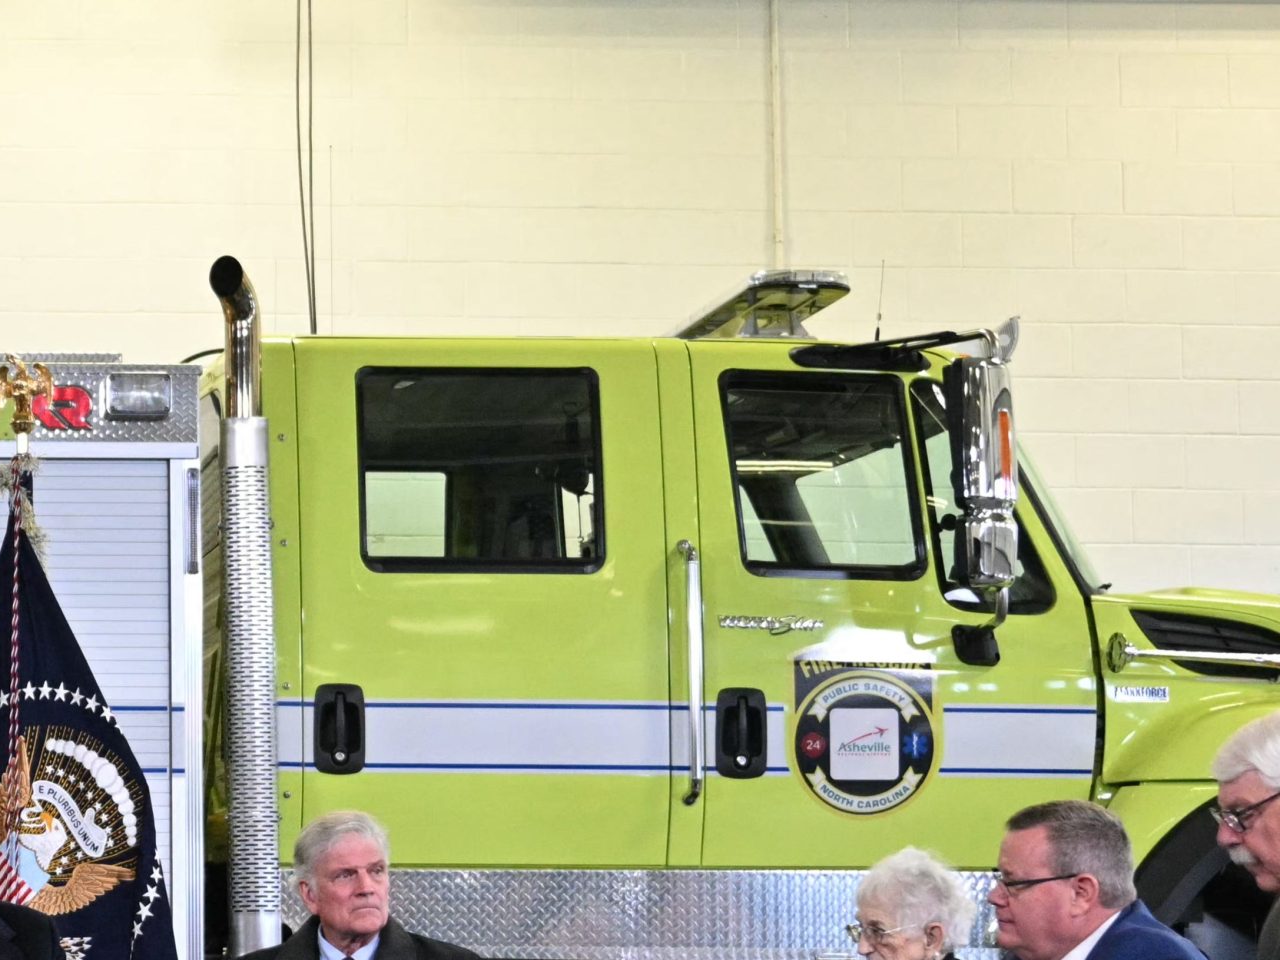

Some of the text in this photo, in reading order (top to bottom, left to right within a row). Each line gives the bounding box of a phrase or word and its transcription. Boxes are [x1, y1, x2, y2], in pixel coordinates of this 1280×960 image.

[822, 682, 906, 704] PUBLIC SAFETY
[806, 740, 820, 750] 24
[837, 741, 891, 753] Asheville
[820, 784, 911, 809] NORTH CAROLINA
[38, 785, 99, 853] E PLURIBUS UNUM
